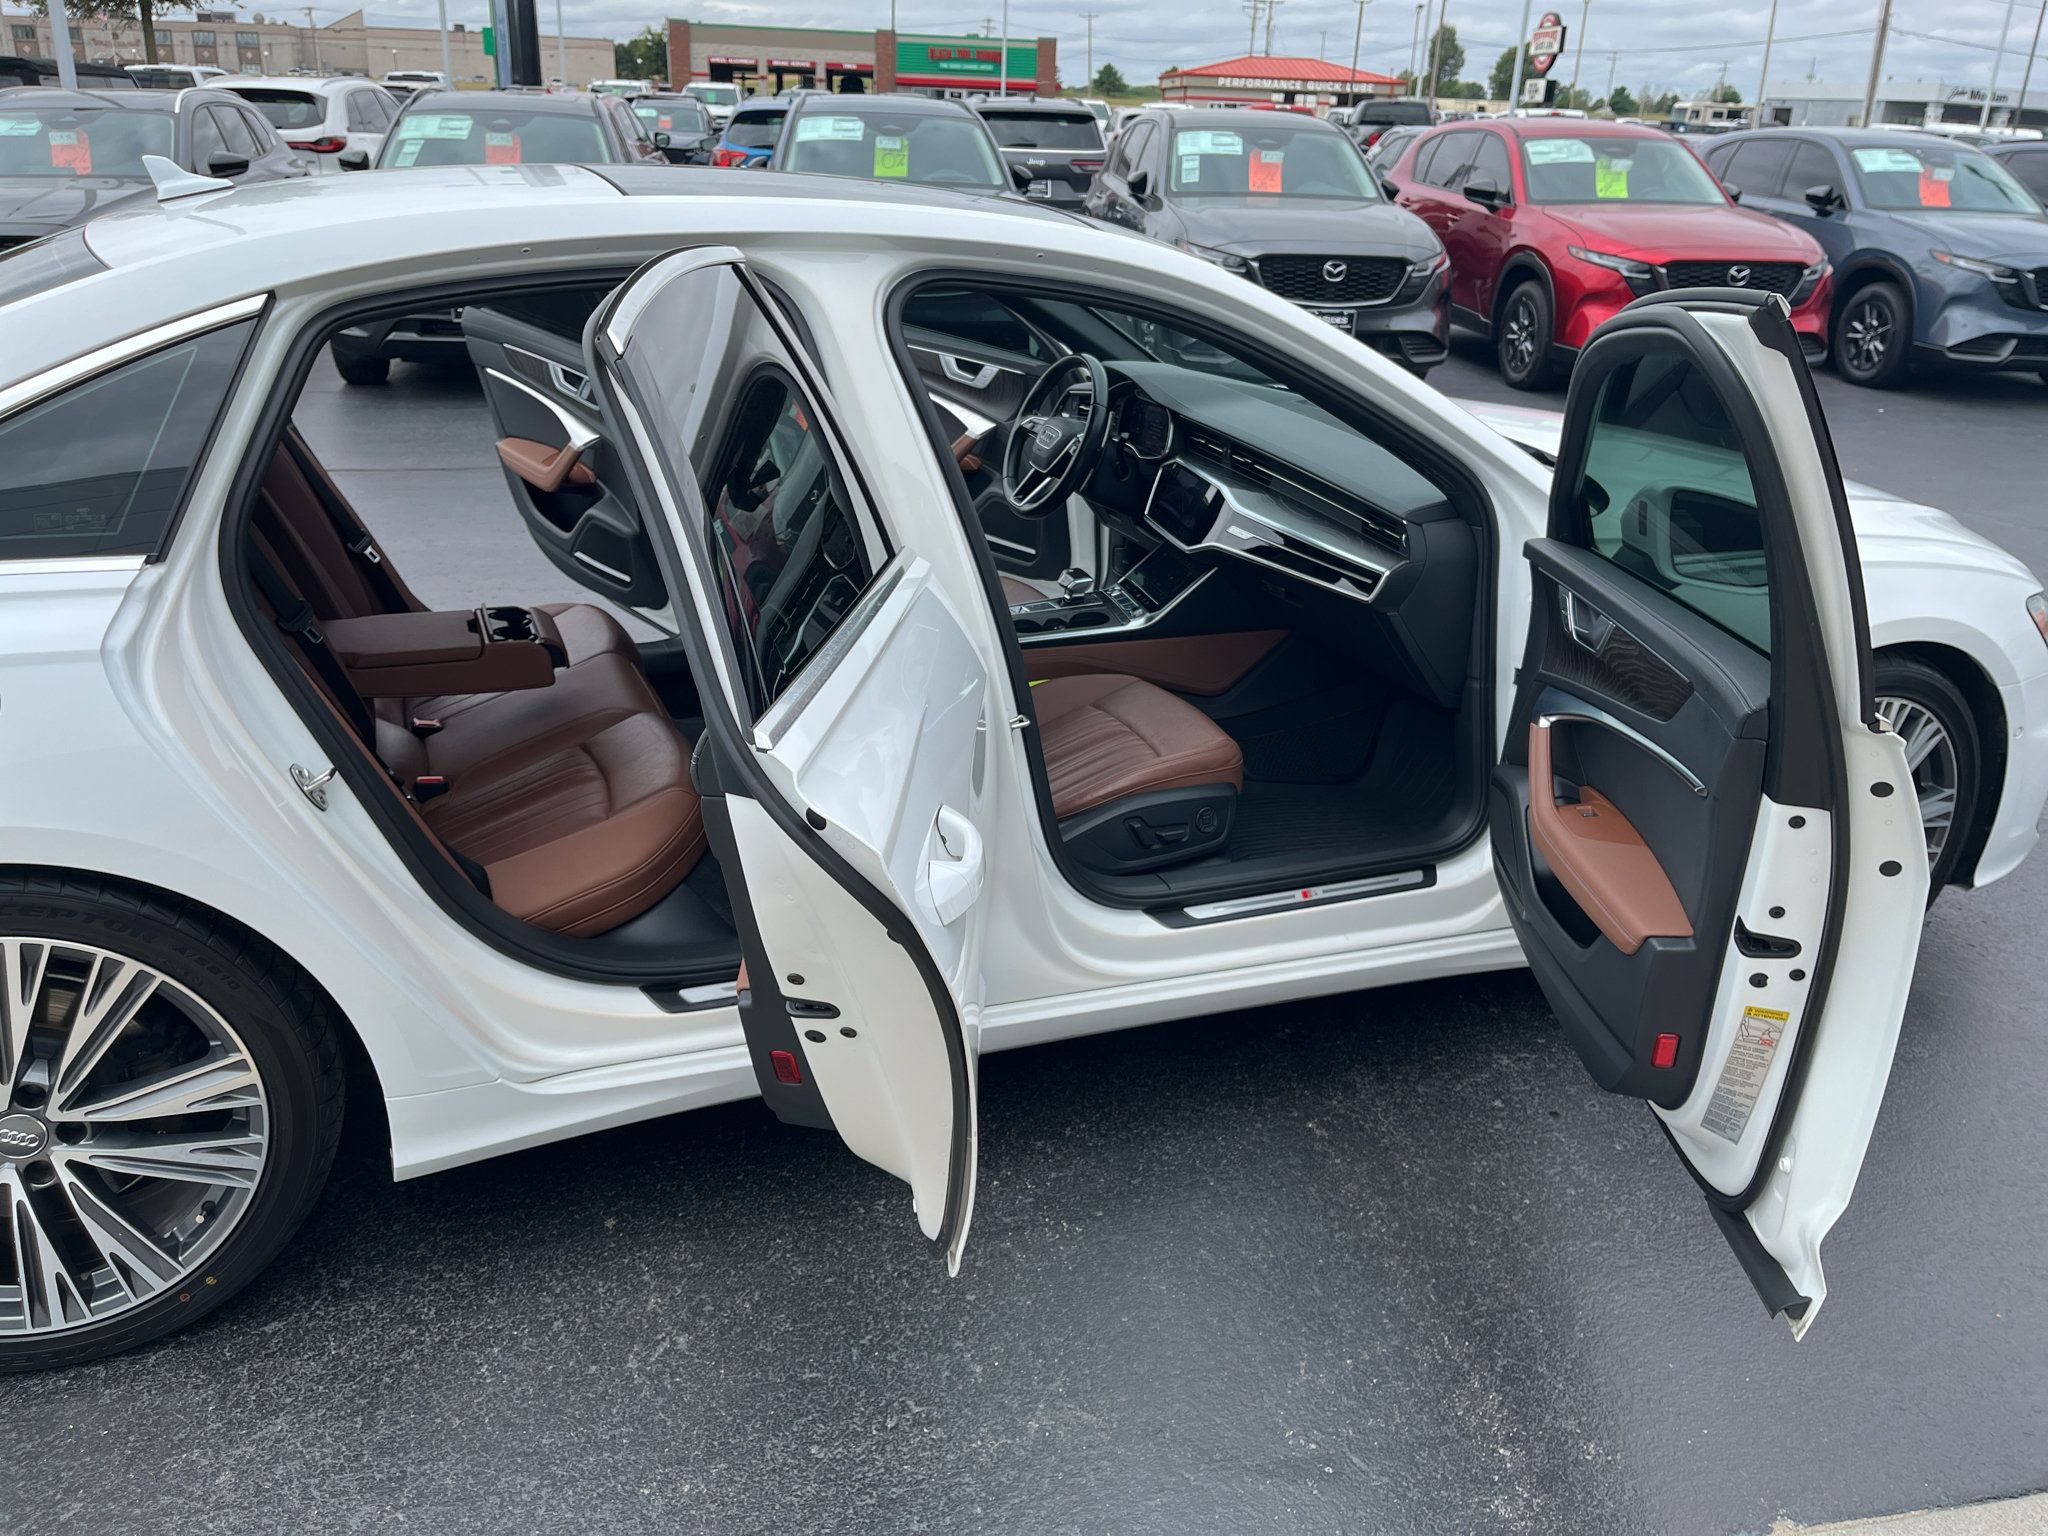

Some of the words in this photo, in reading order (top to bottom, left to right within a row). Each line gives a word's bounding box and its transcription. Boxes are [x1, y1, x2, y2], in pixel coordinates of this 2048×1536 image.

[1217, 77, 1303, 90] PERFORMANCE
[1306, 80, 1342, 92] QUICK
[1345, 82, 1375, 93] LUBE
[1026, 158, 1046, 166] Jeep
[1753, 1013, 1786, 1022] ATTENTION
